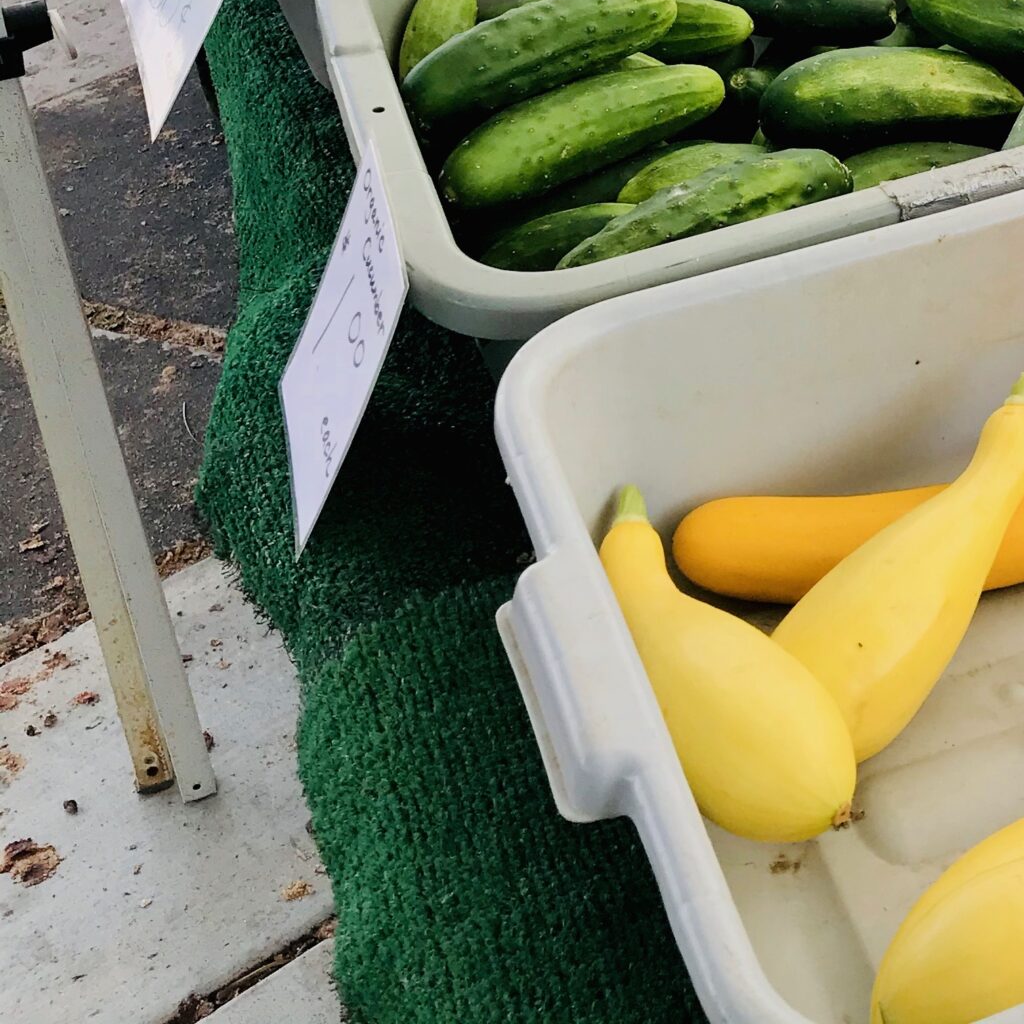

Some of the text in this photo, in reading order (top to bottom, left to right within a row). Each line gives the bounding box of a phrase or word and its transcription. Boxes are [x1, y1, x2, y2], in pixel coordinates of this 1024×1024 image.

[362, 167, 386, 254] Organic
[362, 236, 386, 336] Cucumber
[319, 415, 338, 479] each
